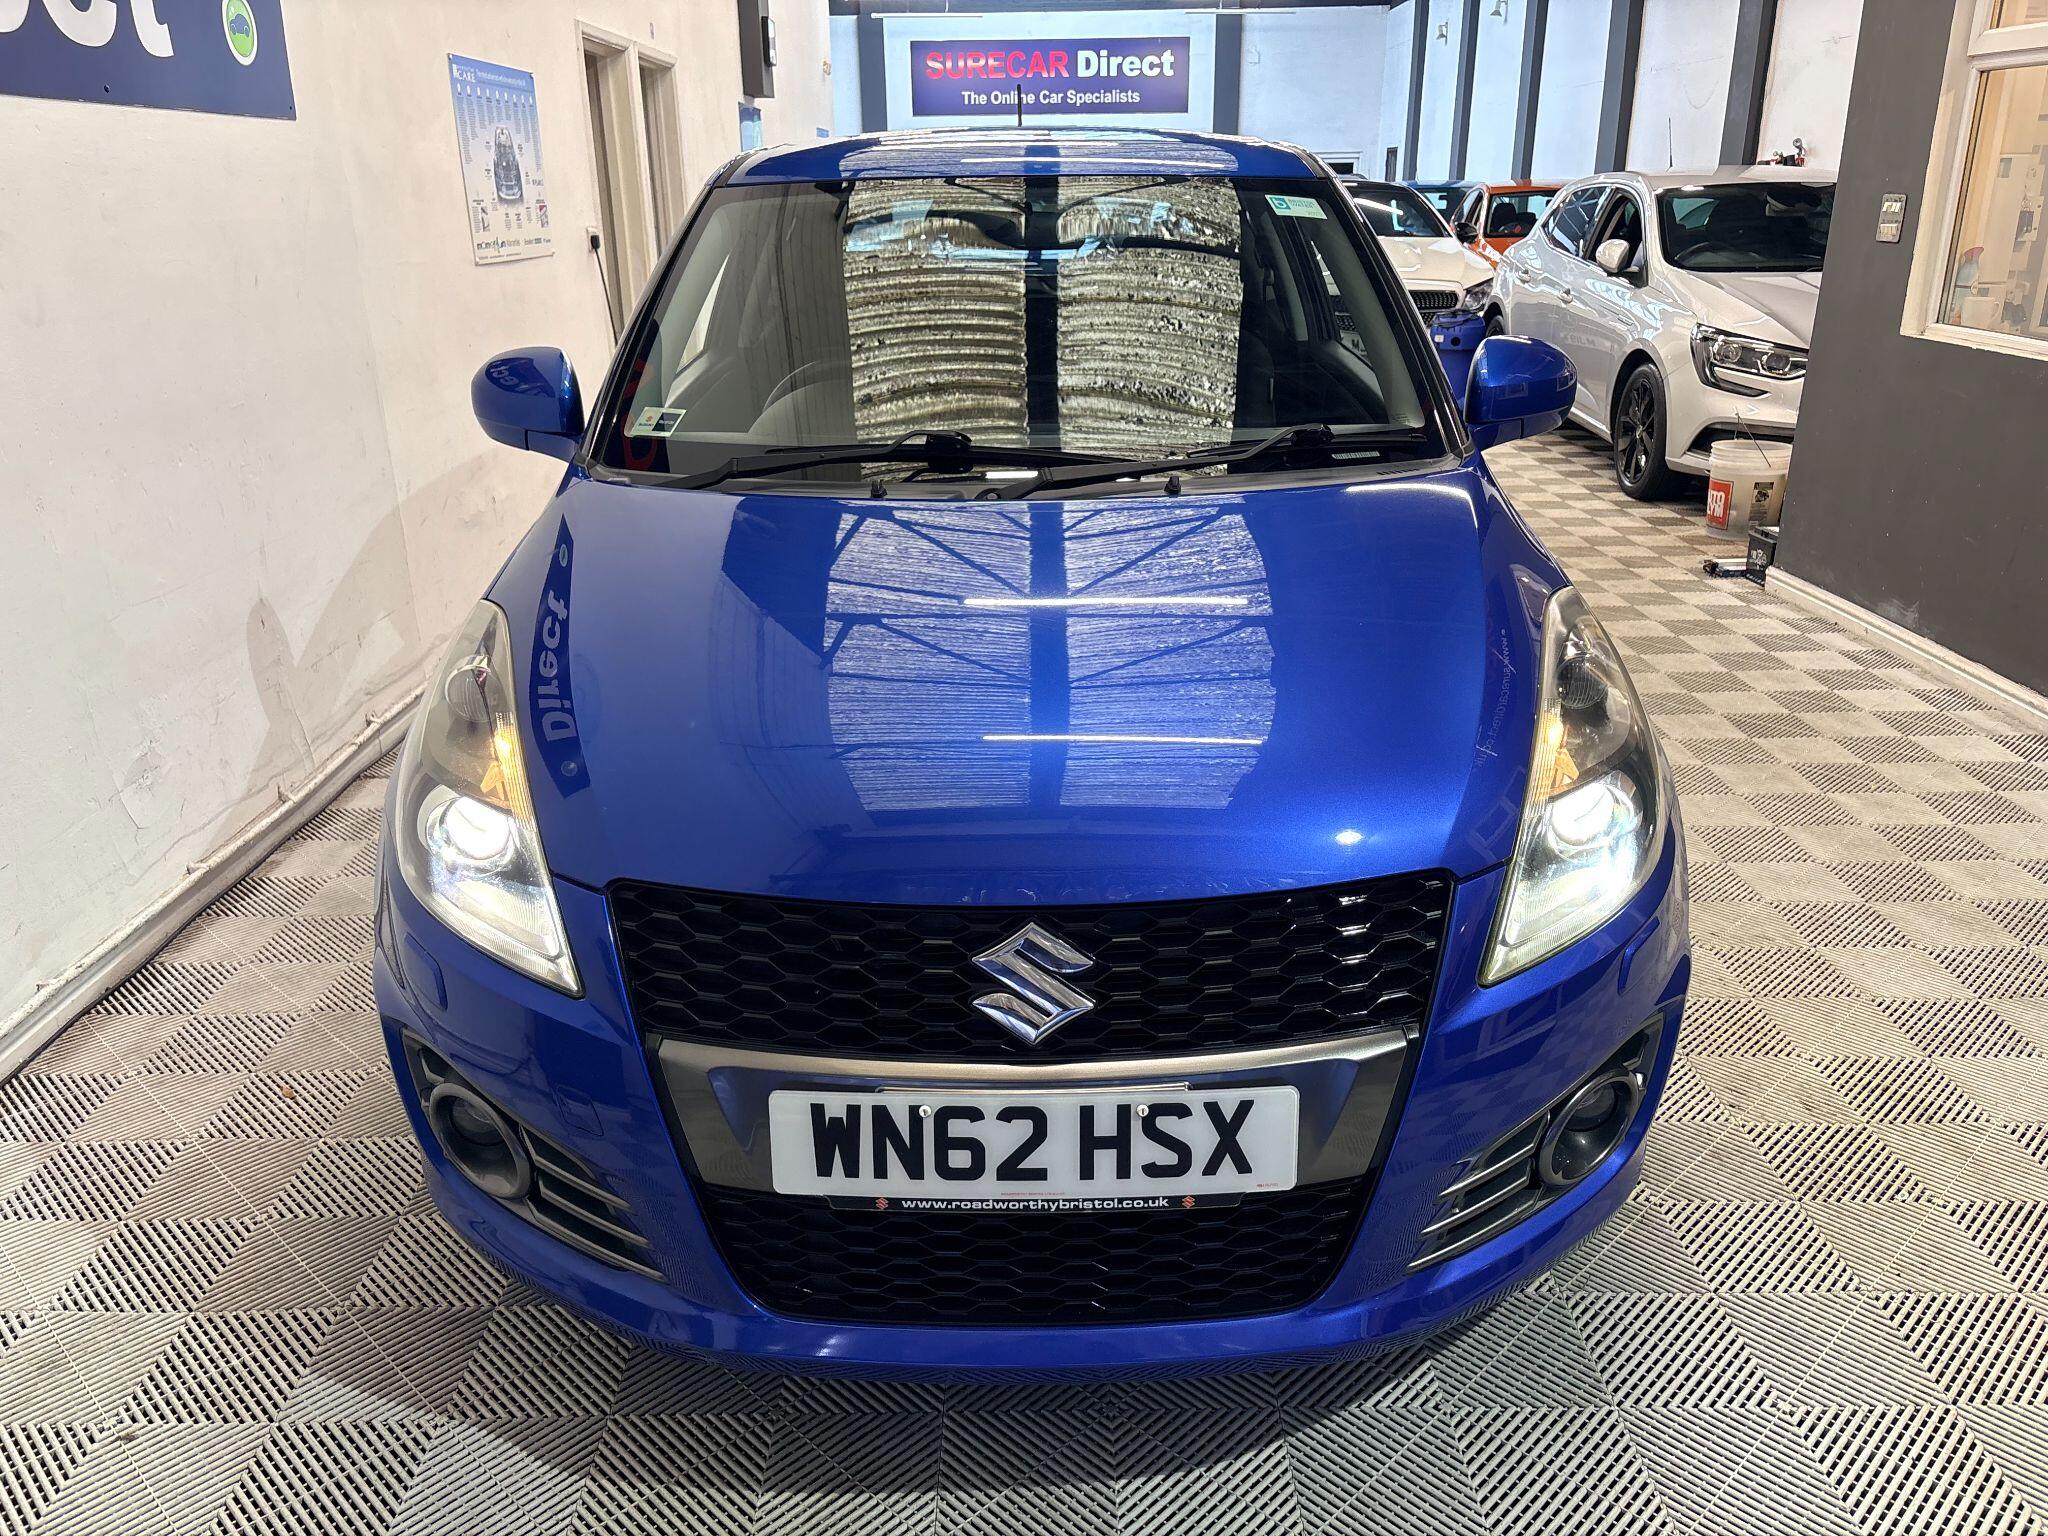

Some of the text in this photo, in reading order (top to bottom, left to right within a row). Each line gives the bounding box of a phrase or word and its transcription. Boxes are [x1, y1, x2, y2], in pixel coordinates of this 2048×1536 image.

[925, 49, 1176, 79] SURECAR Direct
[961, 88, 1141, 106] The Online Car Specialists
[1707, 503, 1724, 518] LYM
[810, 1099, 1255, 1181] WN62 HSX
[901, 1197, 1169, 1211] www.roadworthybristol.co.uk
